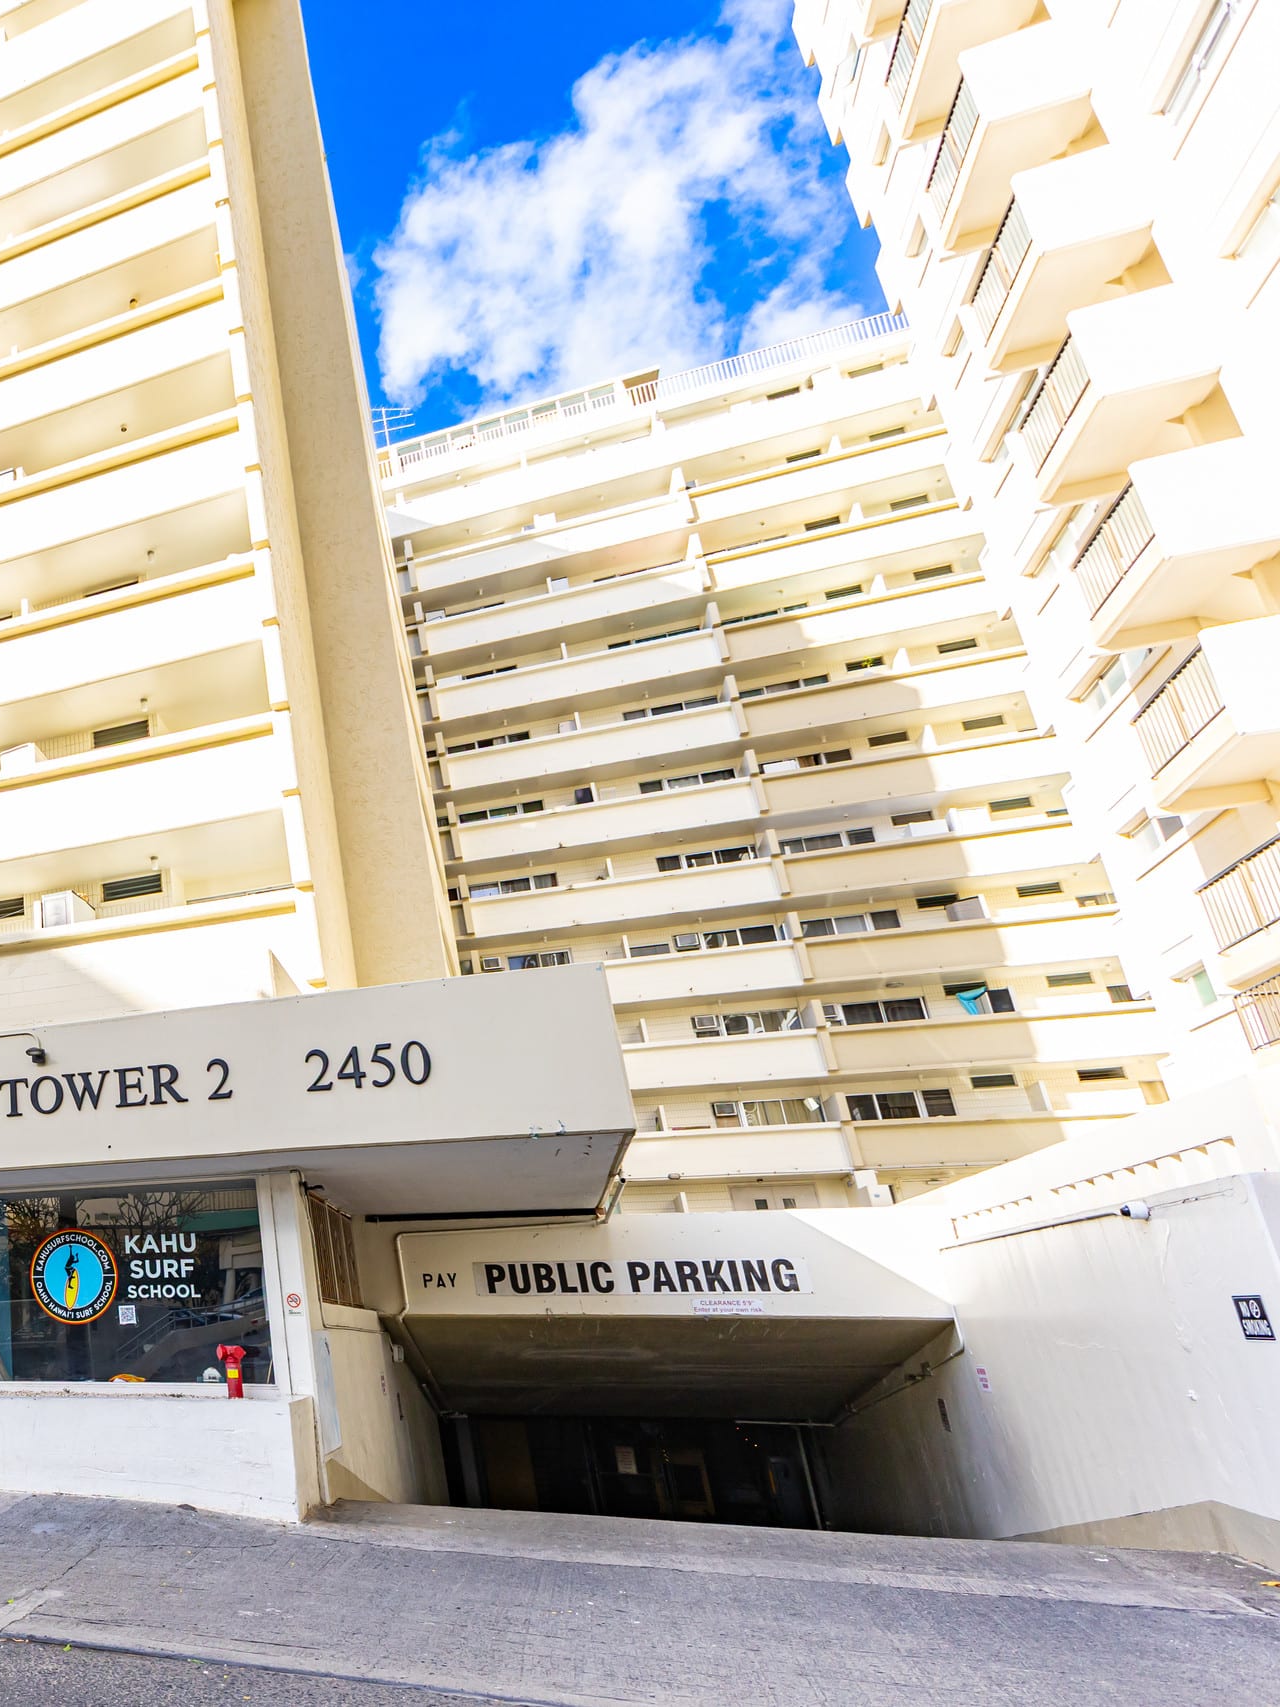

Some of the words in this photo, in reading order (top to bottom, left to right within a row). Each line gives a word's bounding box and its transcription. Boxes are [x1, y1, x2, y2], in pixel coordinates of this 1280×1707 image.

[304, 1040, 432, 1092] 2450
[206, 1058, 233, 1100] 2
[35, 1234, 111, 1272] KAHUSURFSCHOOL.COM
[124, 1233, 196, 1254] KAHU
[130, 1259, 194, 1279] SURF
[484, 1261, 614, 1294] PUBLIC
[627, 1258, 800, 1293] PARKING
[423, 1272, 457, 1288] PAY
[36, 1281, 50, 1303] OAHU
[75, 1307, 94, 1319] SURF
[93, 1280, 113, 1311] SCHOOL
[127, 1283, 202, 1299] SCHOOL
[1238, 1301, 1250, 1317] NO
[1242, 1319, 1272, 1336] SMOKING
